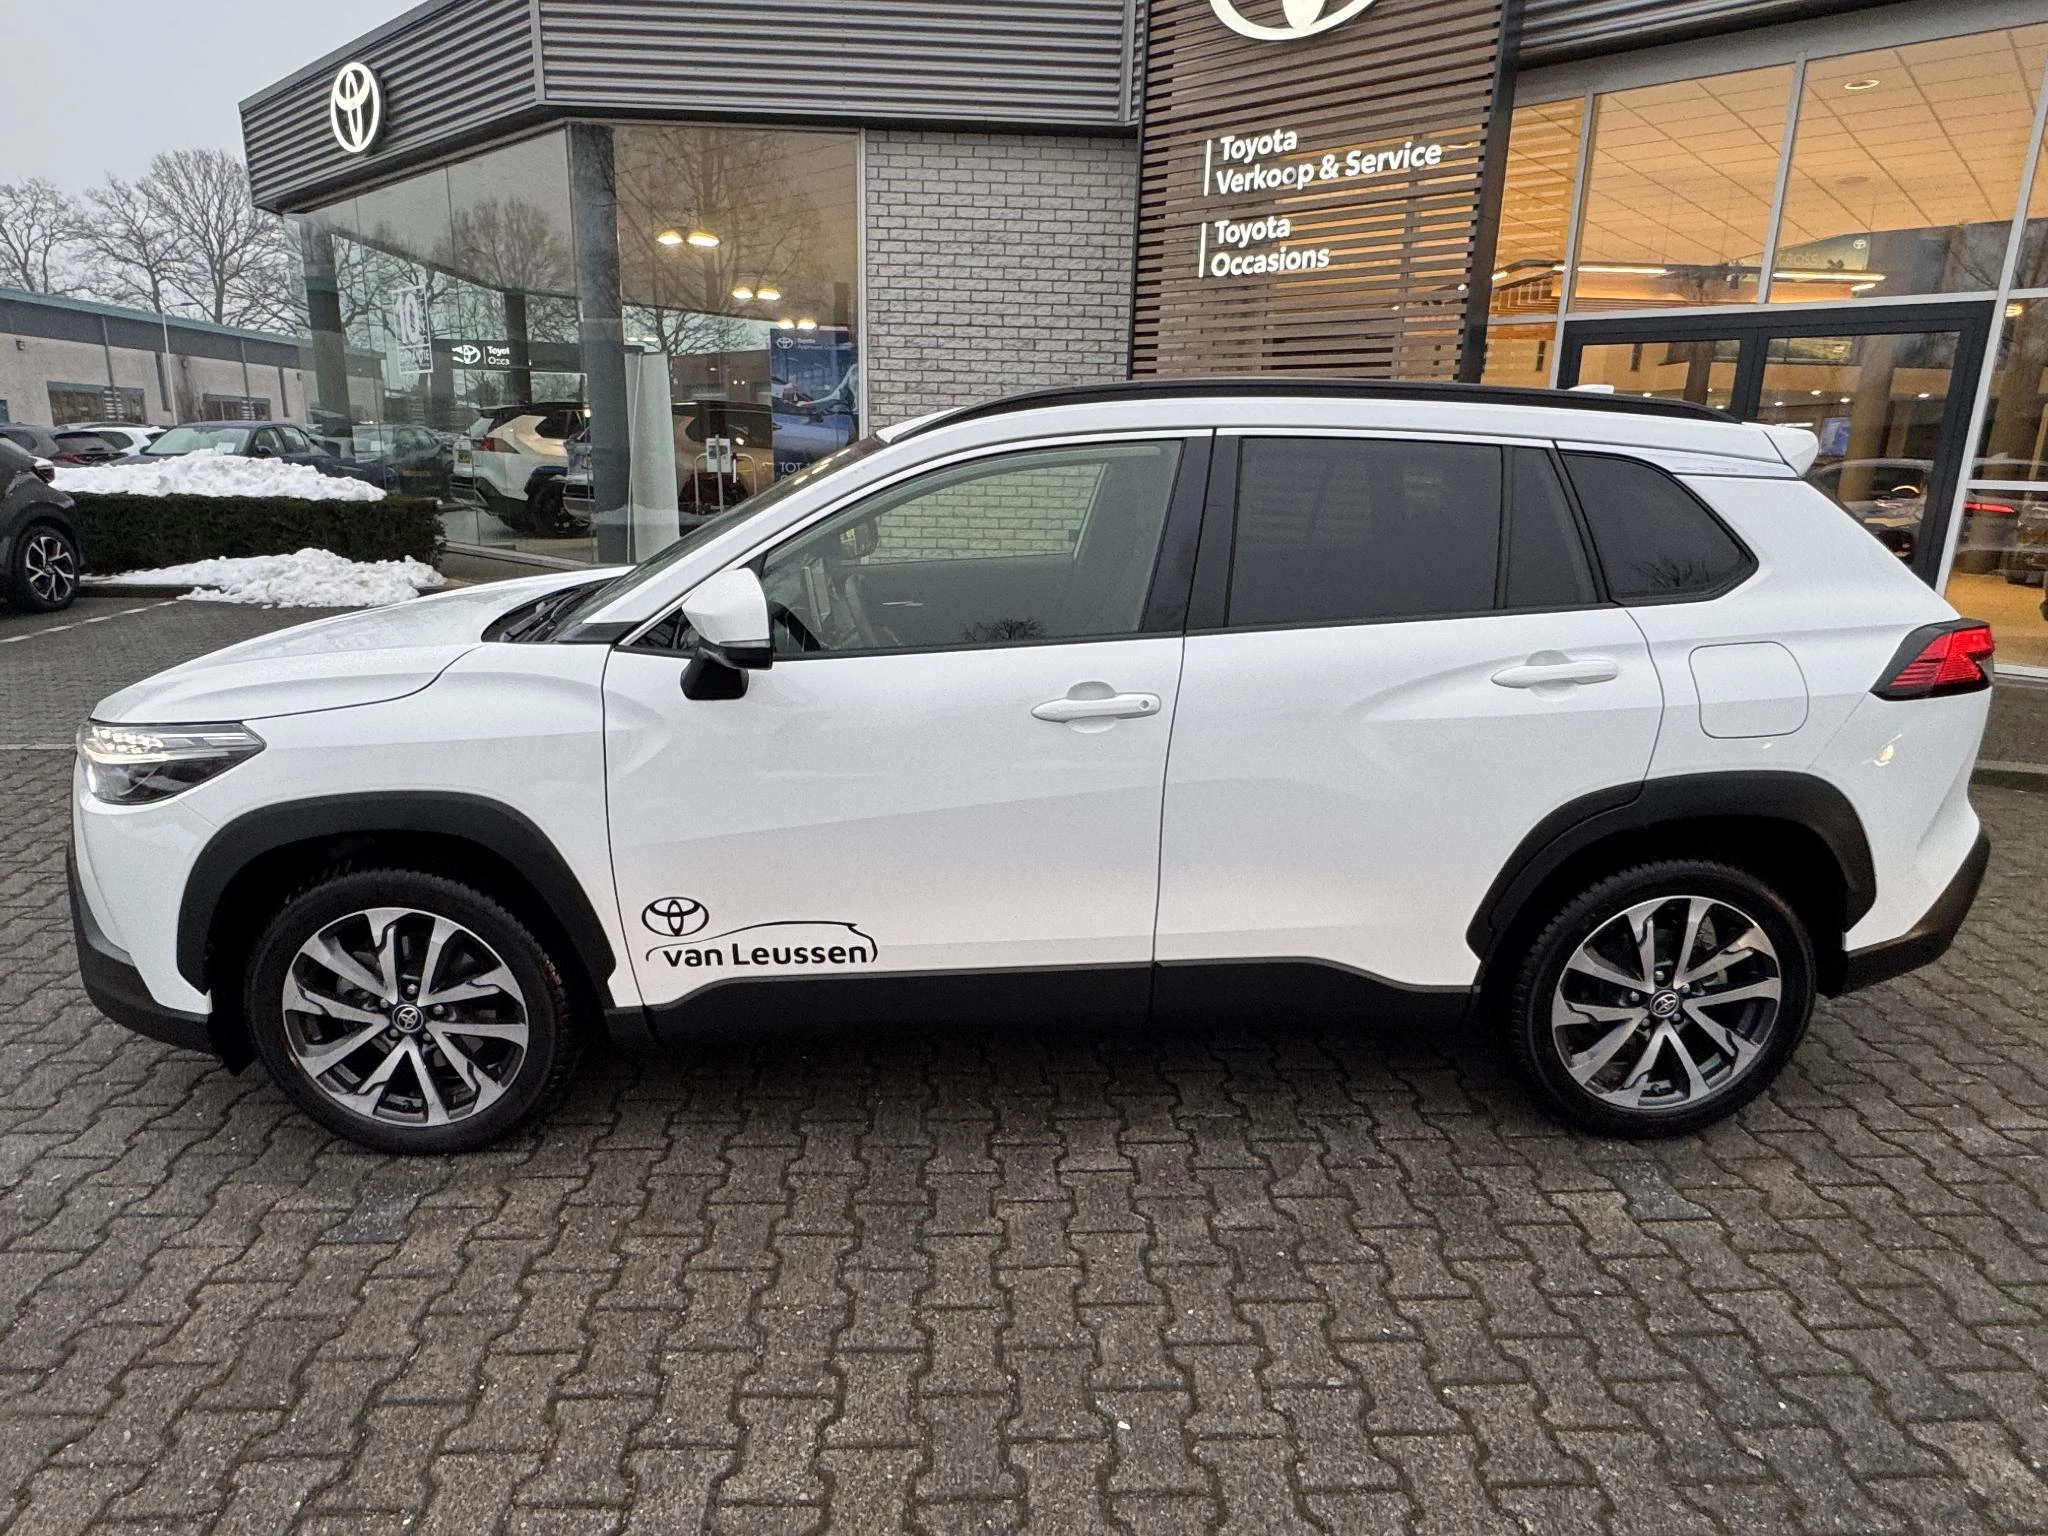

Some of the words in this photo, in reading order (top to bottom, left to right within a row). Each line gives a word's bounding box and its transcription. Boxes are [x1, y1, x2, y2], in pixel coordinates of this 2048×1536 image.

[1220, 129, 1298, 164] Toyota
[1216, 163, 1315, 195] Verkoop
[1319, 154, 1339, 180] &
[1344, 141, 1443, 177] Service
[1214, 215, 1292, 248] Toyota
[1210, 246, 1330, 277] Occasions
[662, 948, 724, 967] van
[731, 943, 868, 967] Leussen
